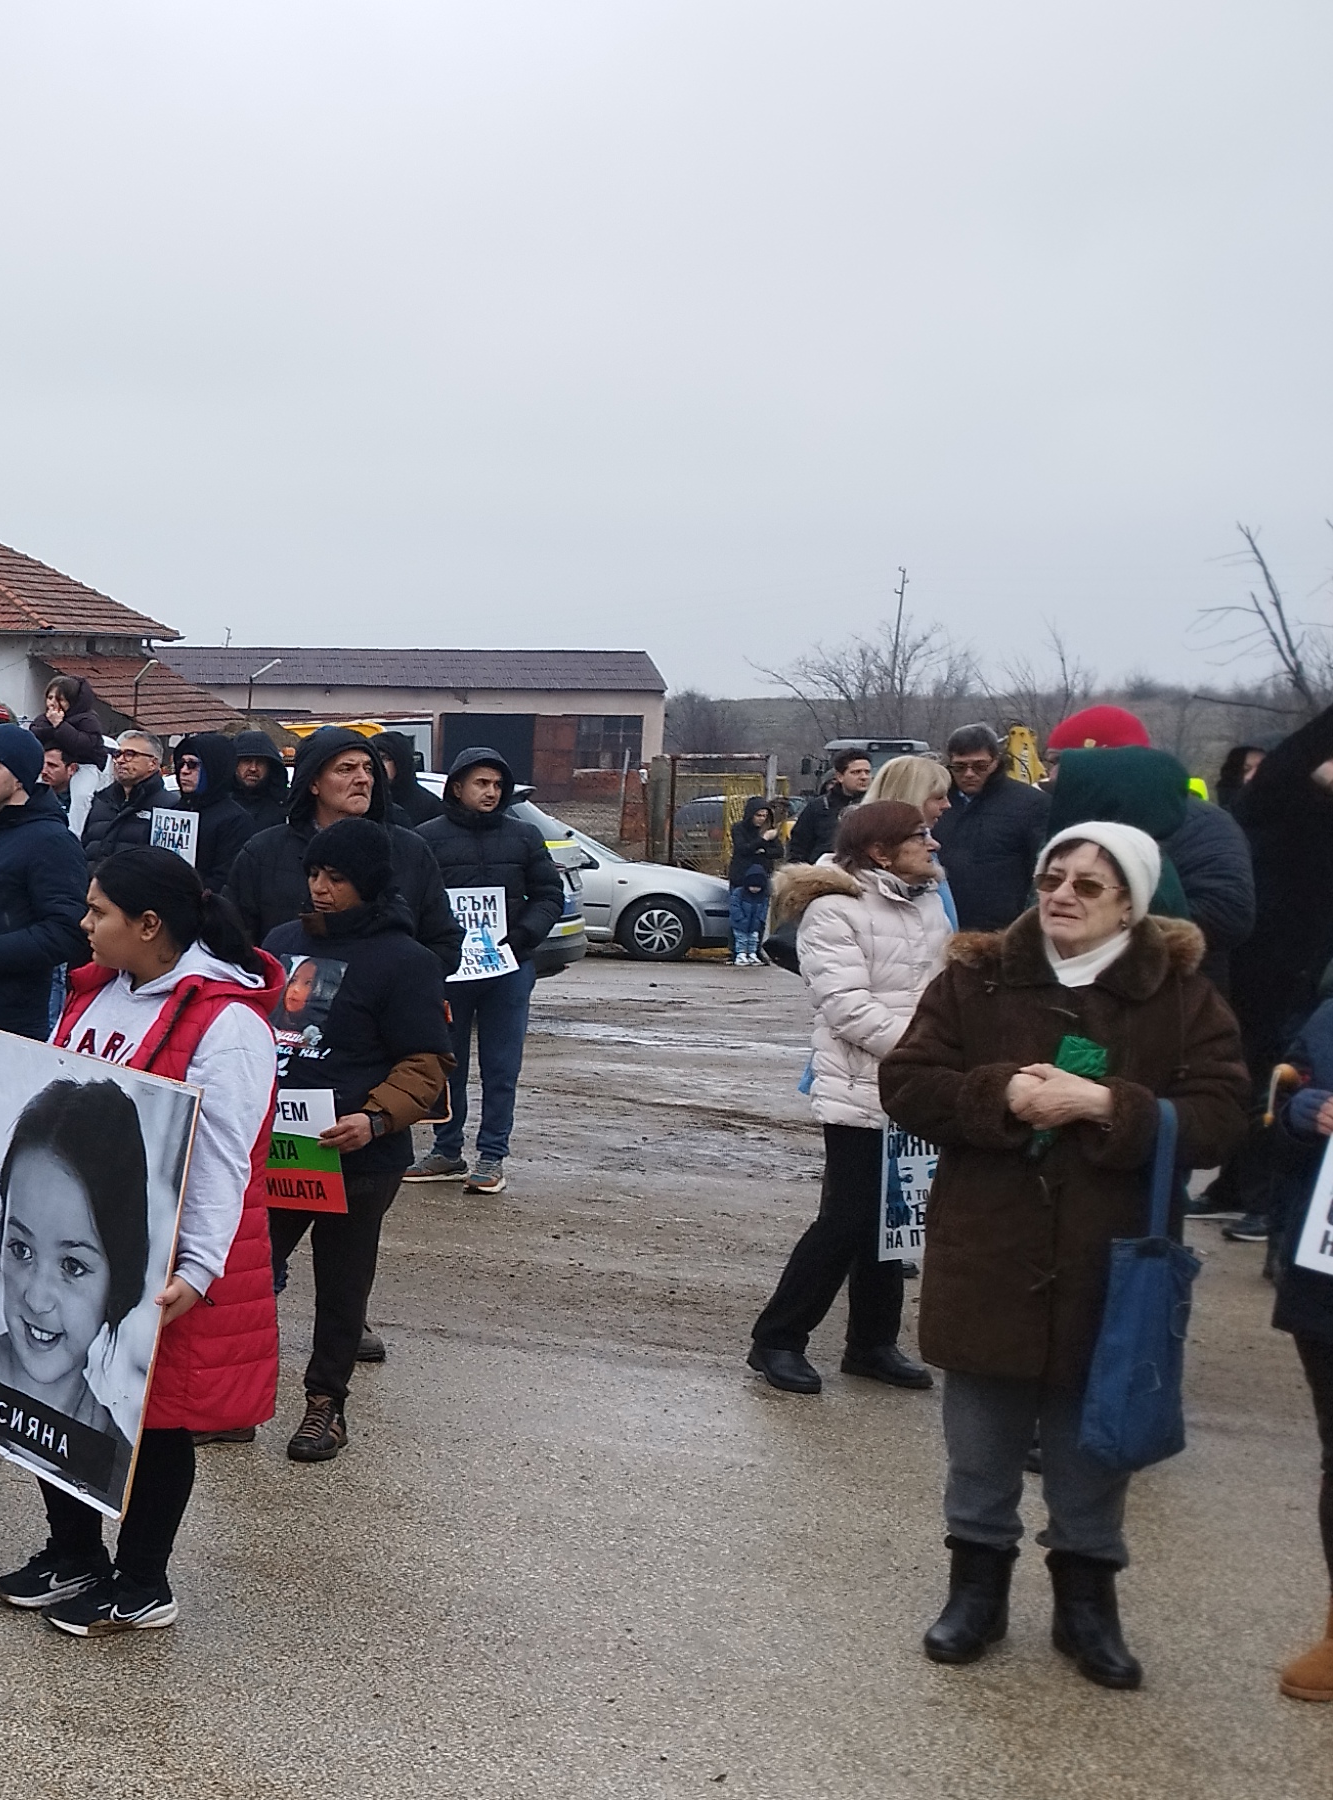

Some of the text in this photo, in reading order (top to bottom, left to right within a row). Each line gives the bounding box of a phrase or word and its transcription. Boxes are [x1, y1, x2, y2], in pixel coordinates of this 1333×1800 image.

[163, 815, 191, 833] СЪМ
[456, 895, 497, 911] СЪМ
[886, 1230, 904, 1250] НА
